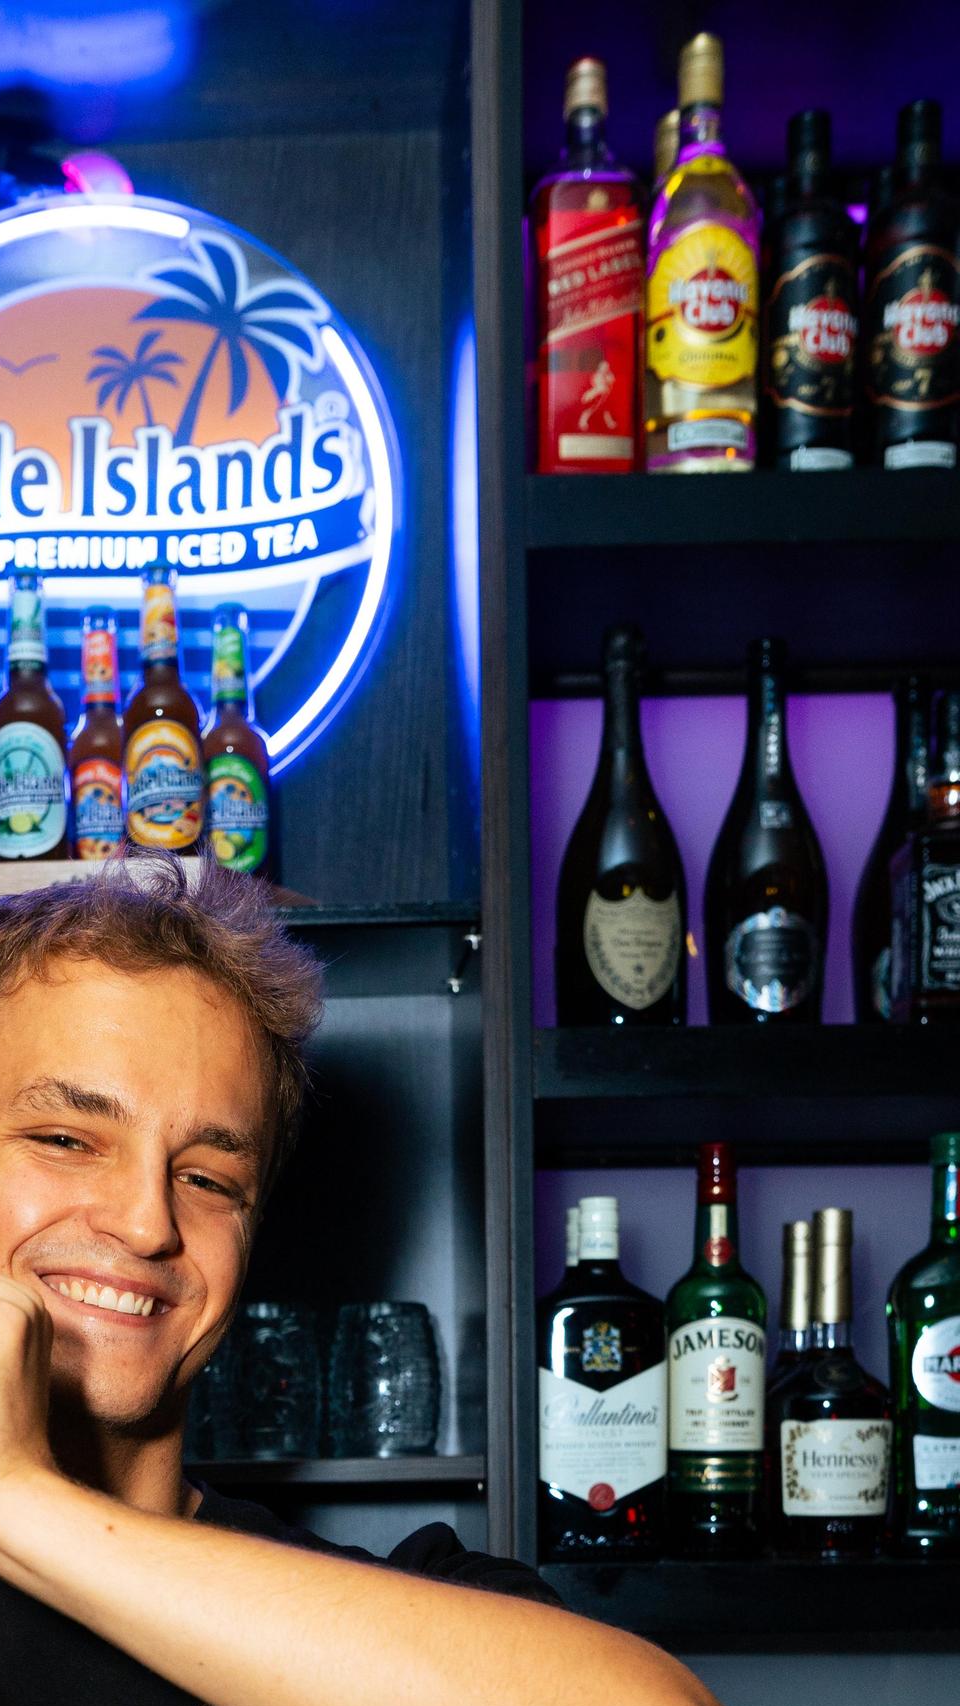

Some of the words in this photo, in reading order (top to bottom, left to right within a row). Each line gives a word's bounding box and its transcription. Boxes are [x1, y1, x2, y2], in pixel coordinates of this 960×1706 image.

[76, 405, 346, 518] Islands
[166, 530, 246, 567] ICED
[253, 519, 319, 560] TEA
[673, 1329, 764, 1361] JAMESON
[802, 1450, 880, 1471] Hennessy
